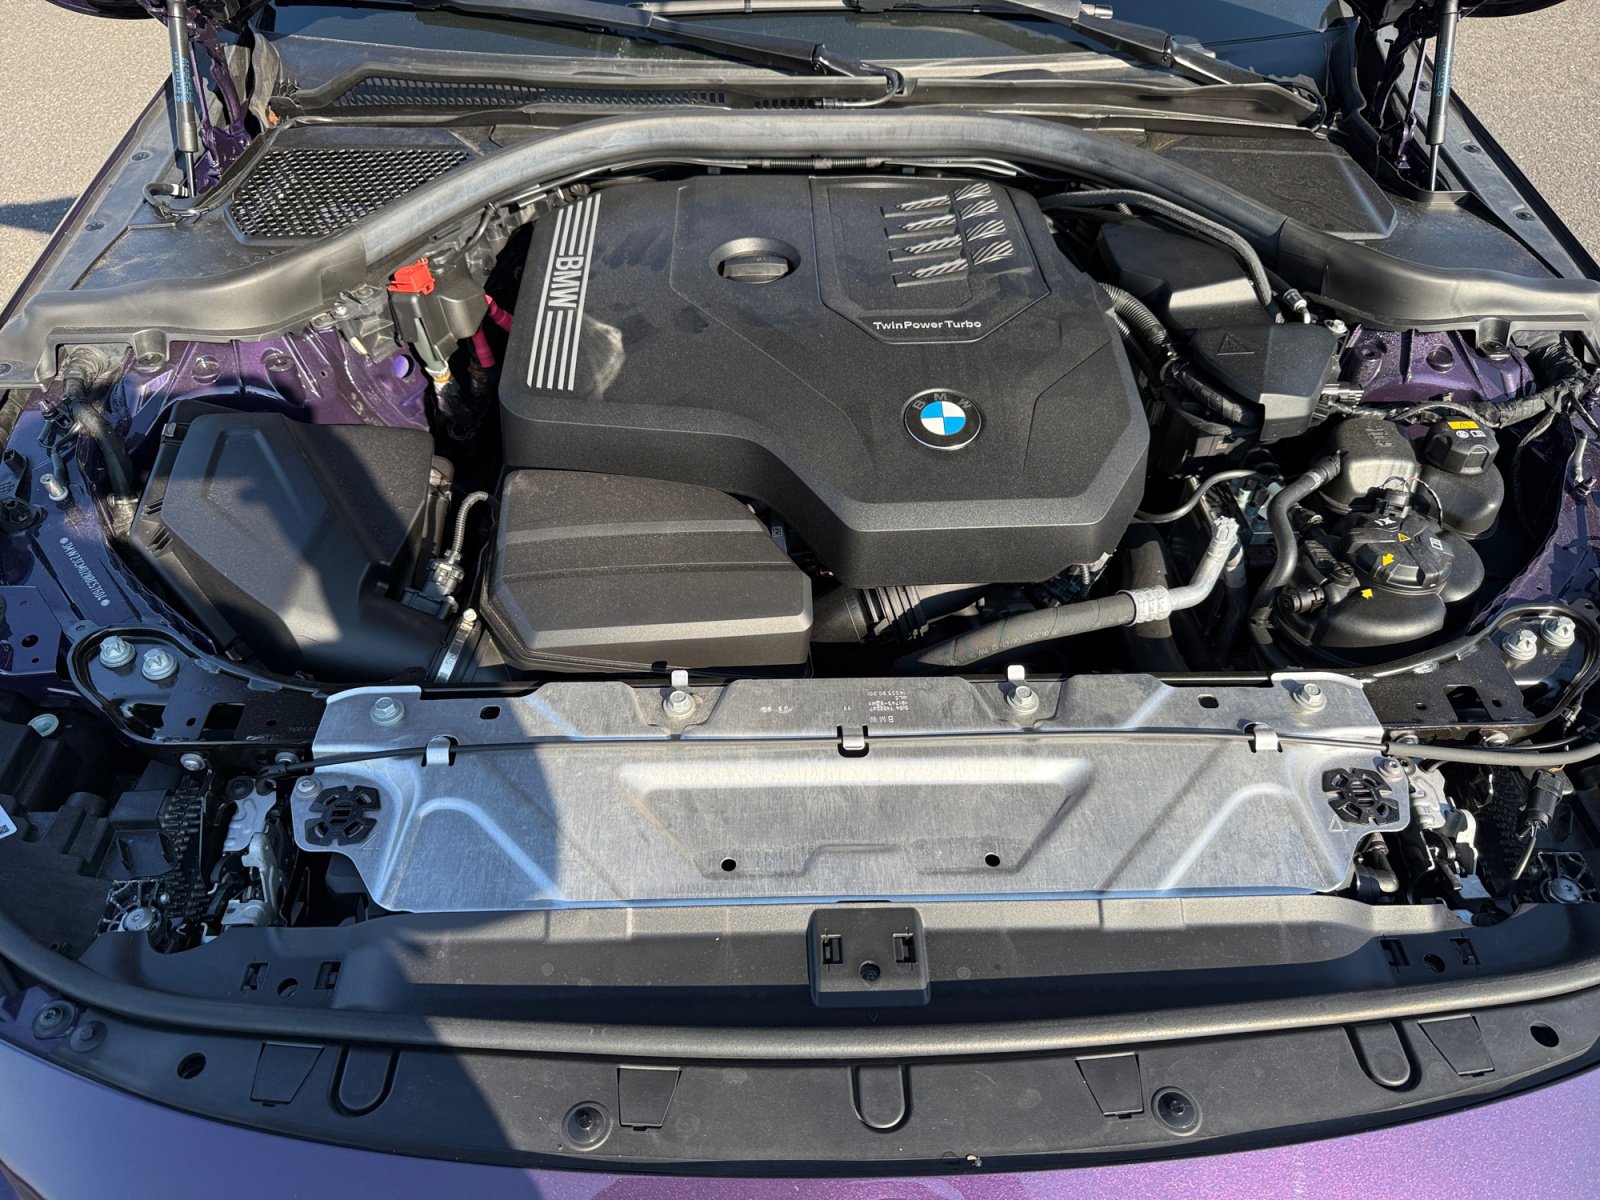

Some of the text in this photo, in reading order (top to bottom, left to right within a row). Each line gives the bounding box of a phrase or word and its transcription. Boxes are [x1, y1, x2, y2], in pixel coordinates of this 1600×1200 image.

[548, 256, 584, 308] BMW
[912, 392, 972, 410] BMW
[870, 715, 894, 723] BMW
